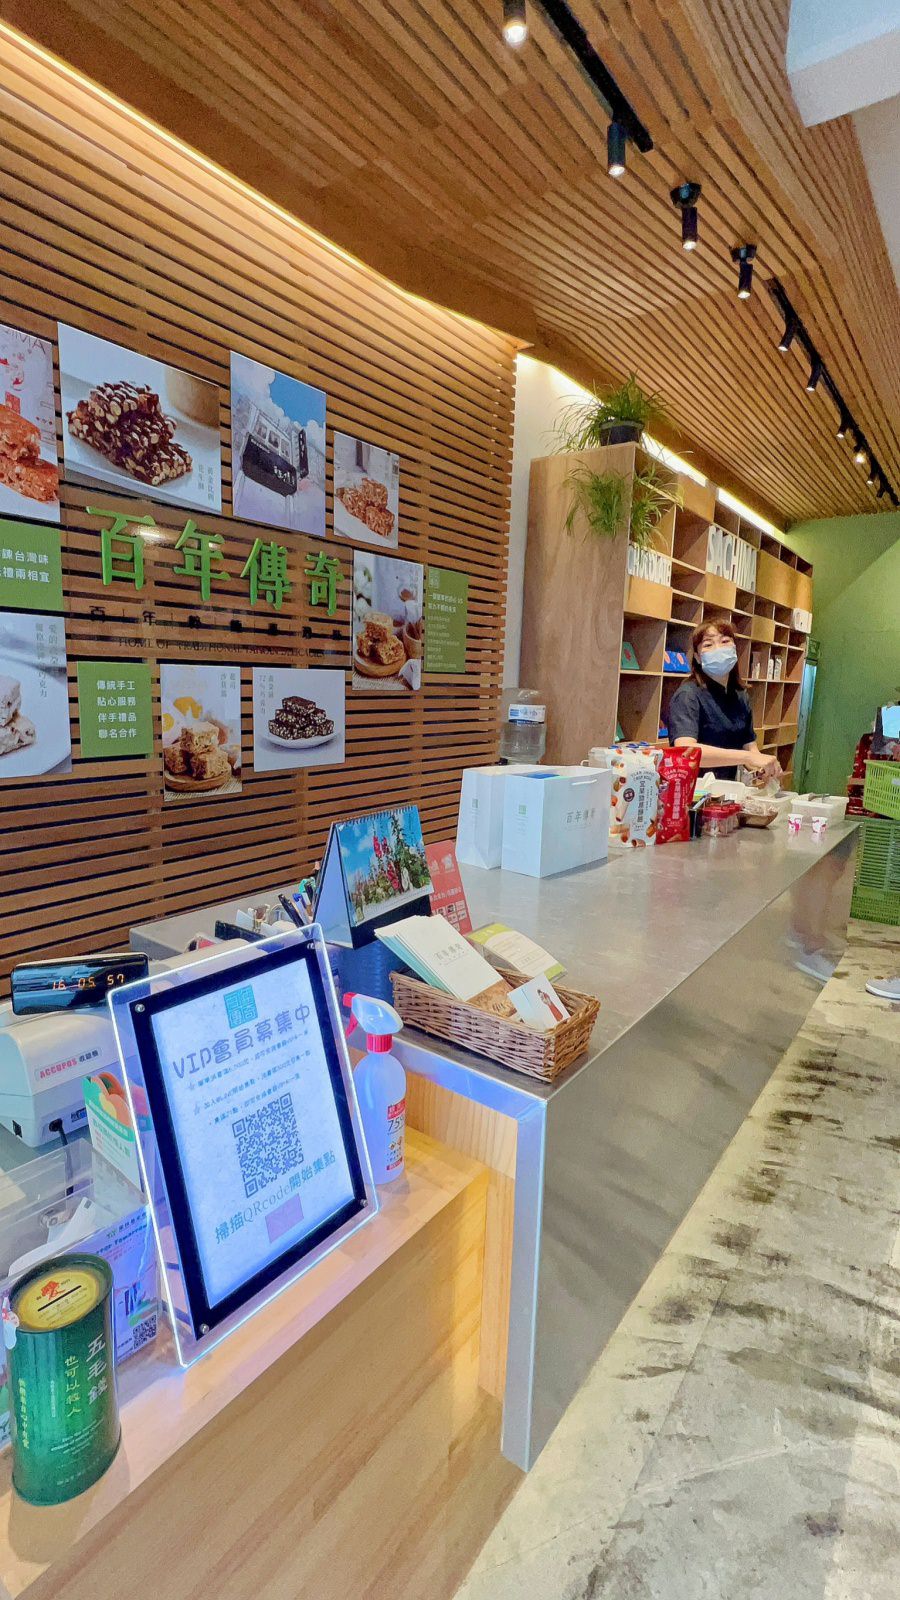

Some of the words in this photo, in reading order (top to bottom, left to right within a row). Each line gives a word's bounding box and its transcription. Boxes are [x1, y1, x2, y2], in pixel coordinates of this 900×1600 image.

[86, 506, 345, 617] 百年傳奇
[0, 566, 50, 583] 禮兩相宜
[97, 680, 136, 691] 傳統手工
[97, 696, 137, 706] 貼心服務
[98, 712, 137, 723] 伴手禮品
[98, 728, 137, 739] 聯名合作
[52, 980, 67, 991] 16
[78, 976, 97, 990] 05
[107, 973, 125, 986] 57
[172, 1003, 310, 1079] VIP會員募集中
[215, 1150, 336, 1245] 掃描QRcode開始集點
[86, 1333, 108, 1406] 五毛錢
